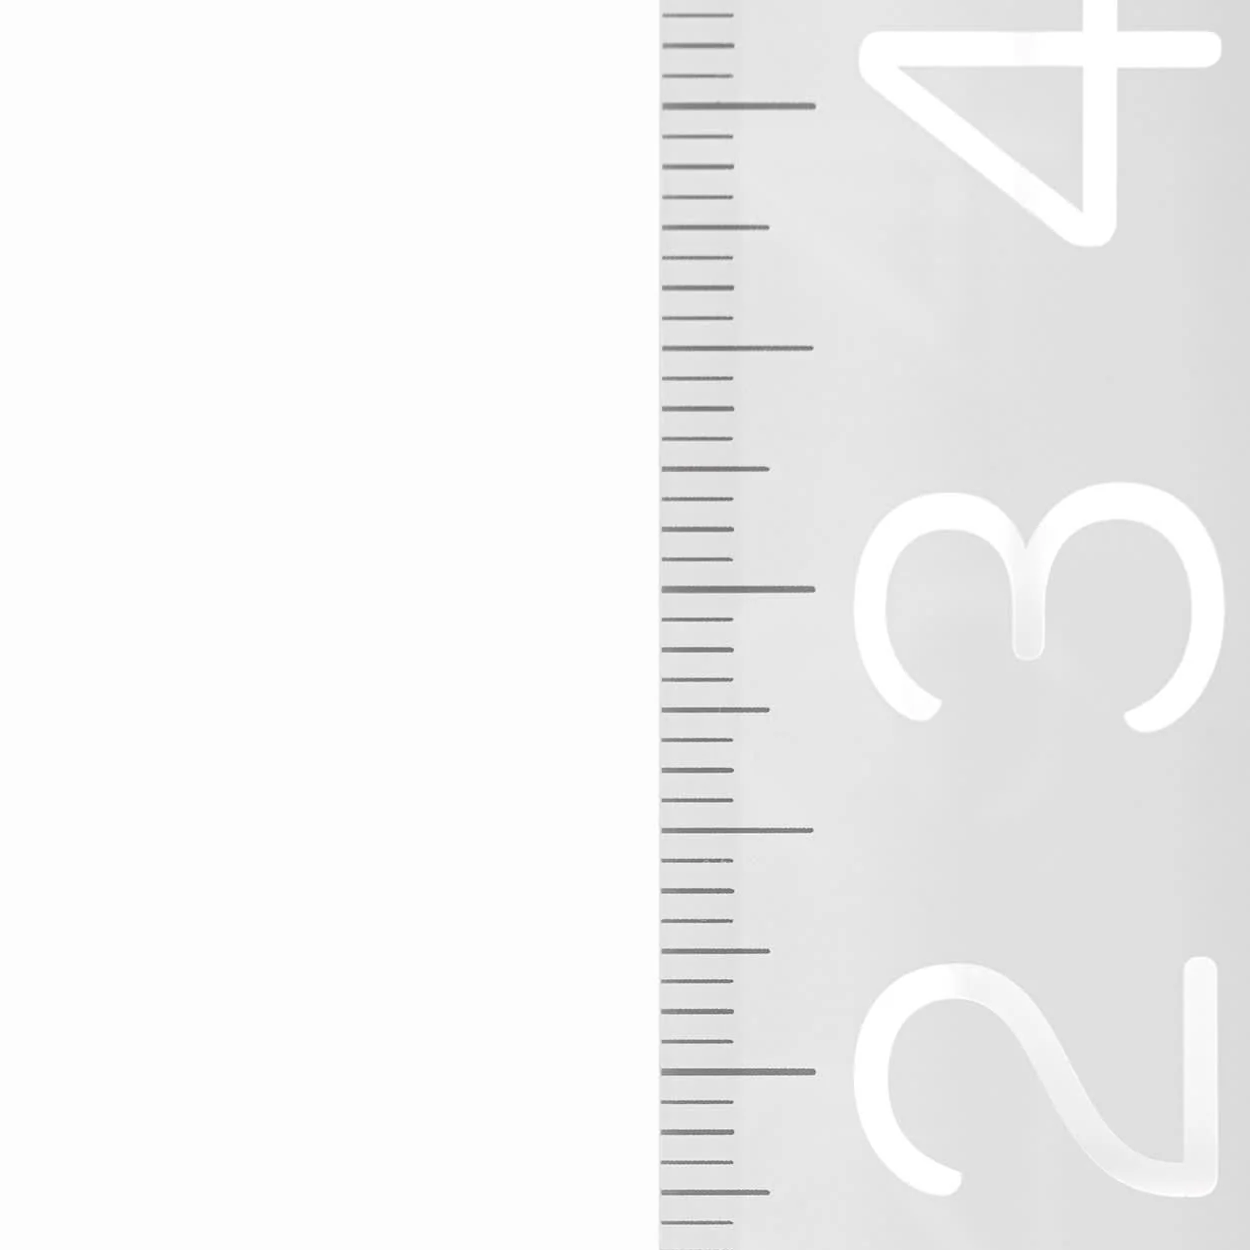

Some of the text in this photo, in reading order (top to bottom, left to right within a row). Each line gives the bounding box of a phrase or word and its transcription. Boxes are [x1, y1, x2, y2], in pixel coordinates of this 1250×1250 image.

[858, 0, 1222, 247] 4
[853, 482, 1226, 733] 3
[853, 956, 1219, 1198] 2
